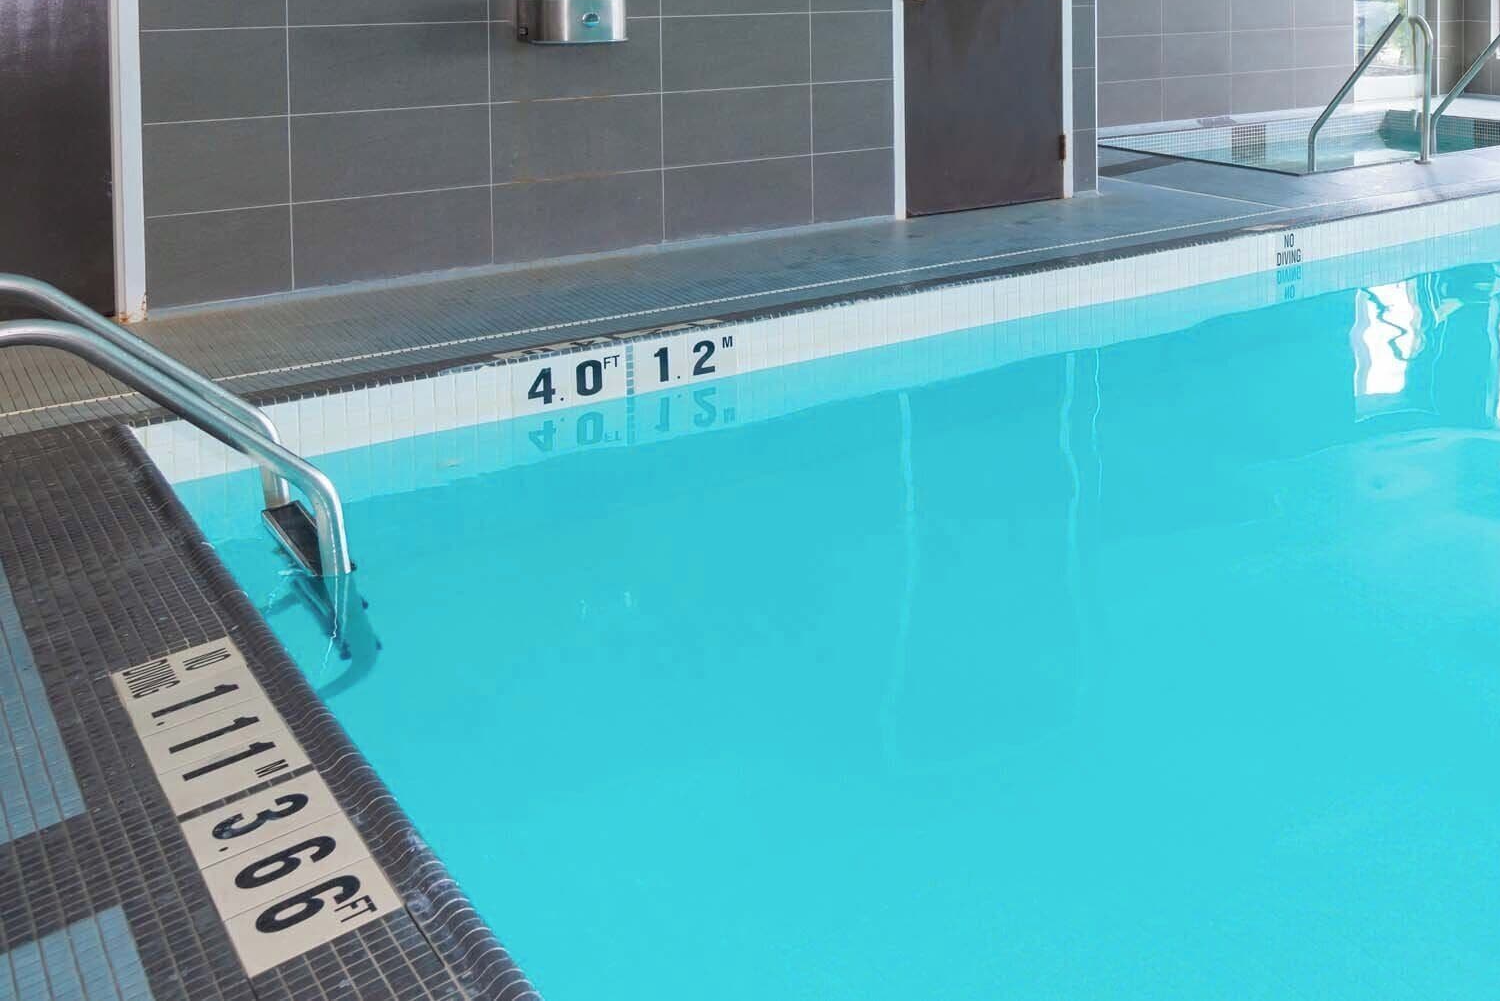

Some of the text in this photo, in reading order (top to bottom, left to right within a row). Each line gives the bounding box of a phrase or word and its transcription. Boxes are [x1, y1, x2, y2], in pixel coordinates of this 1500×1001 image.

[1284, 233, 1295, 248] NO
[1276, 248, 1302, 266] DIVING
[182, 647, 232, 671] NO
[122, 658, 181, 699] DIVING
